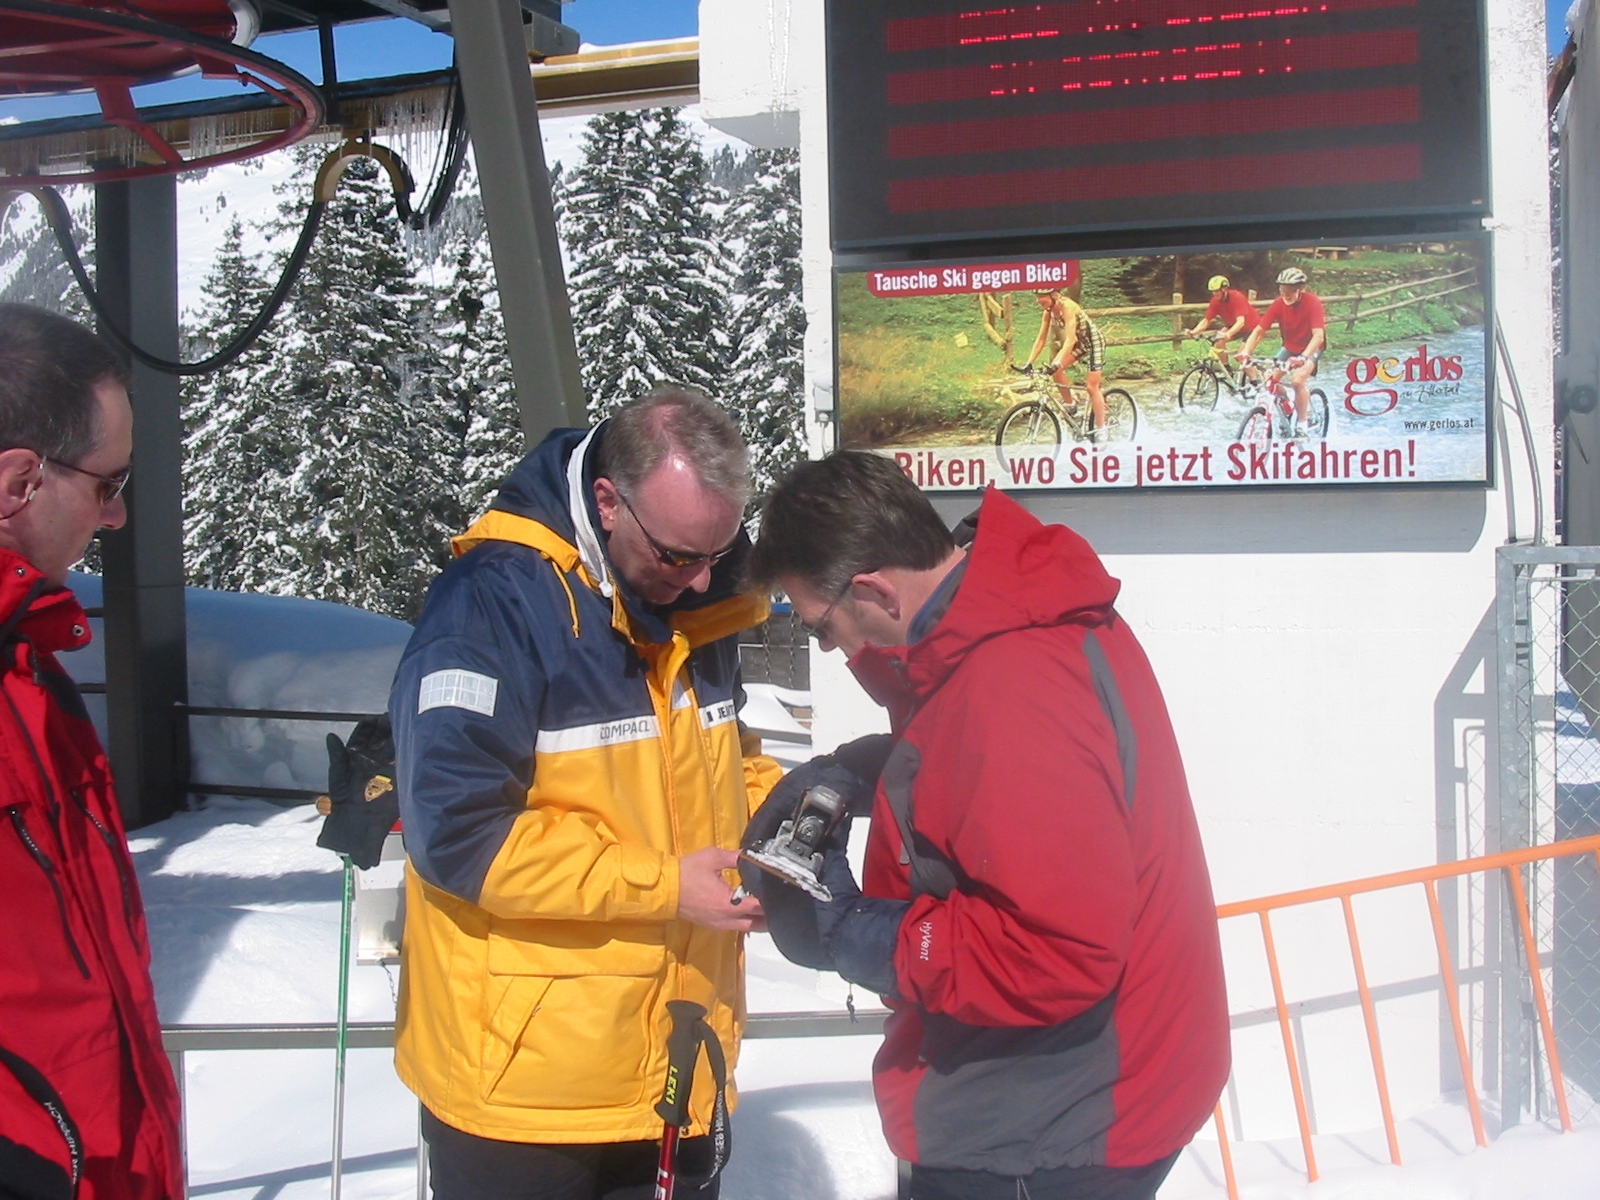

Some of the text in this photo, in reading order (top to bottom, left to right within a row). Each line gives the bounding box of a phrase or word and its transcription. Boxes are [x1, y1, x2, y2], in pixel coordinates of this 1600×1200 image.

[874, 262, 1067, 291] Tausche Ski gegen Bike!
[1344, 344, 1463, 416] gerlos
[1404, 418, 1474, 431] www.gerlos.at
[1010, 457, 1055, 485] wo
[1070, 447, 1120, 484] Sie
[1134, 446, 1213, 487] jetzt
[1227, 440, 1415, 481] Skifahren!
[665, 1064, 679, 1106] LEKI
